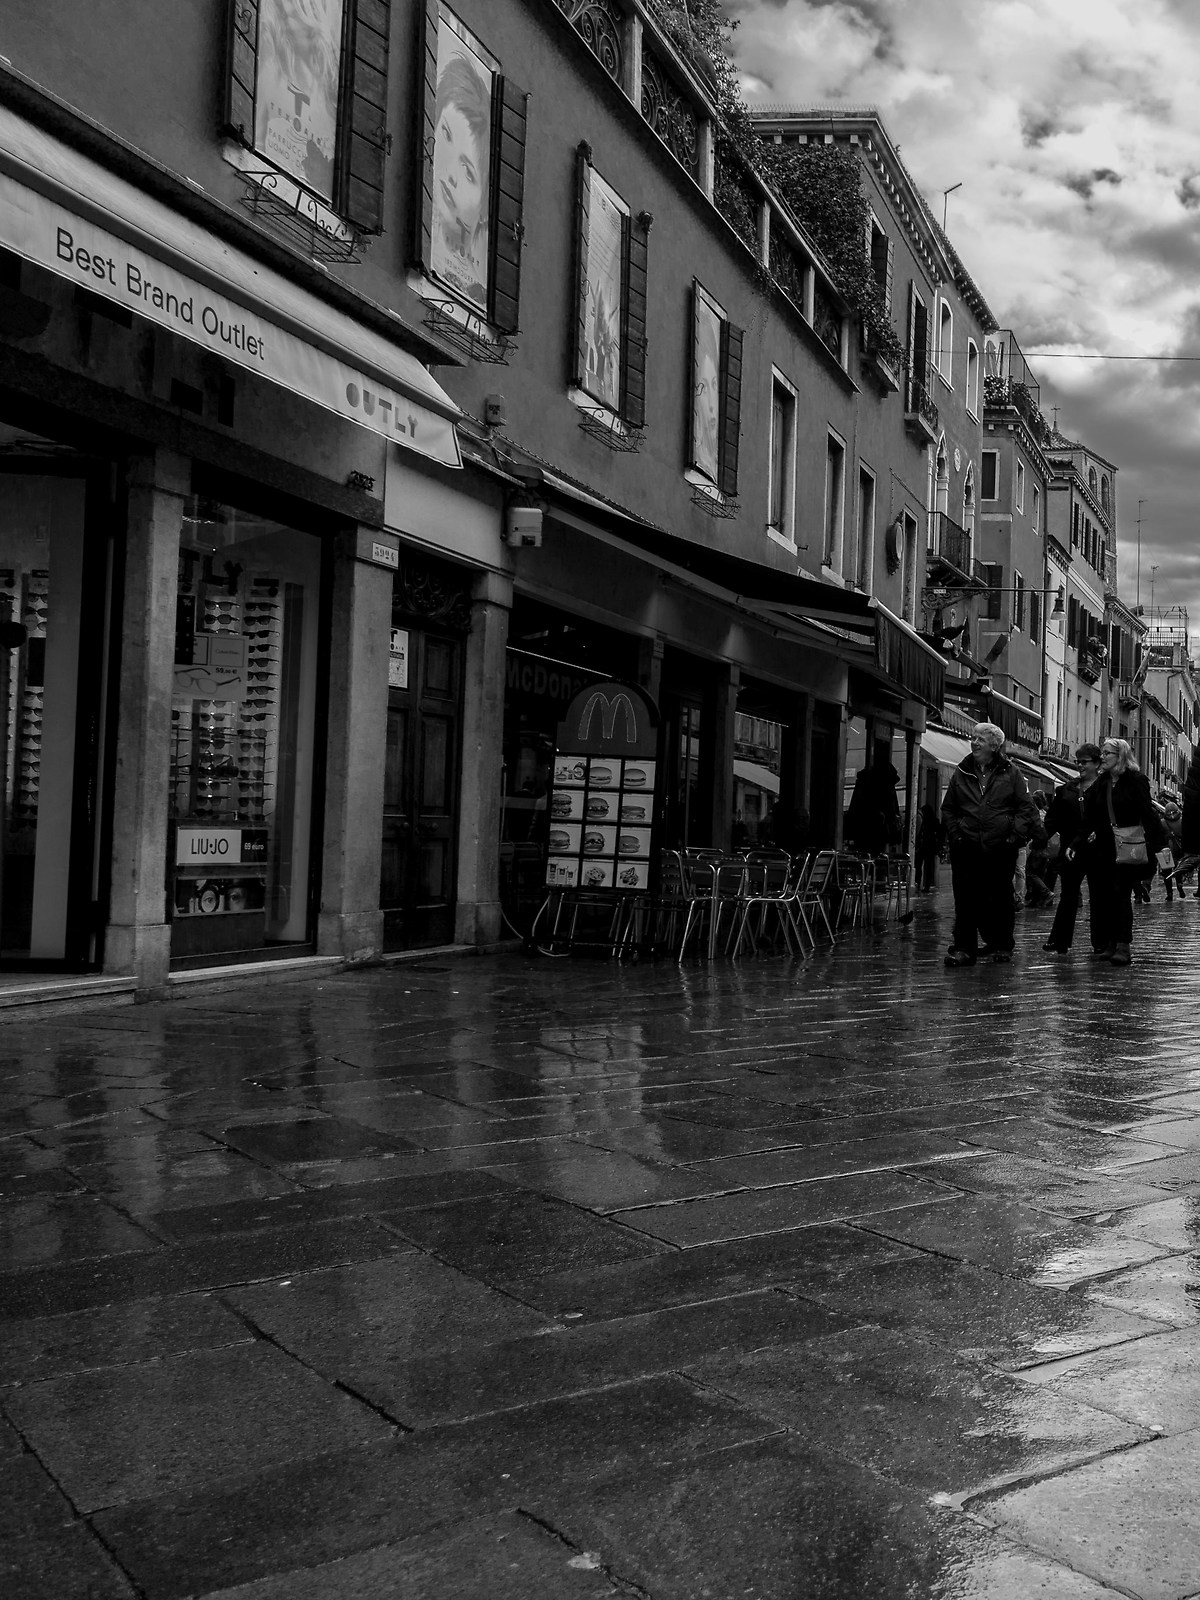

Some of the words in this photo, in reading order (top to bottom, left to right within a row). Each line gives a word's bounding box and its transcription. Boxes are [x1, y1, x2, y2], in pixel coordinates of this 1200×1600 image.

[56, 226, 117, 287] Best
[126, 262, 194, 325] Brand
[202, 306, 265, 361] Outlet
[345, 382, 419, 439] OUTLY
